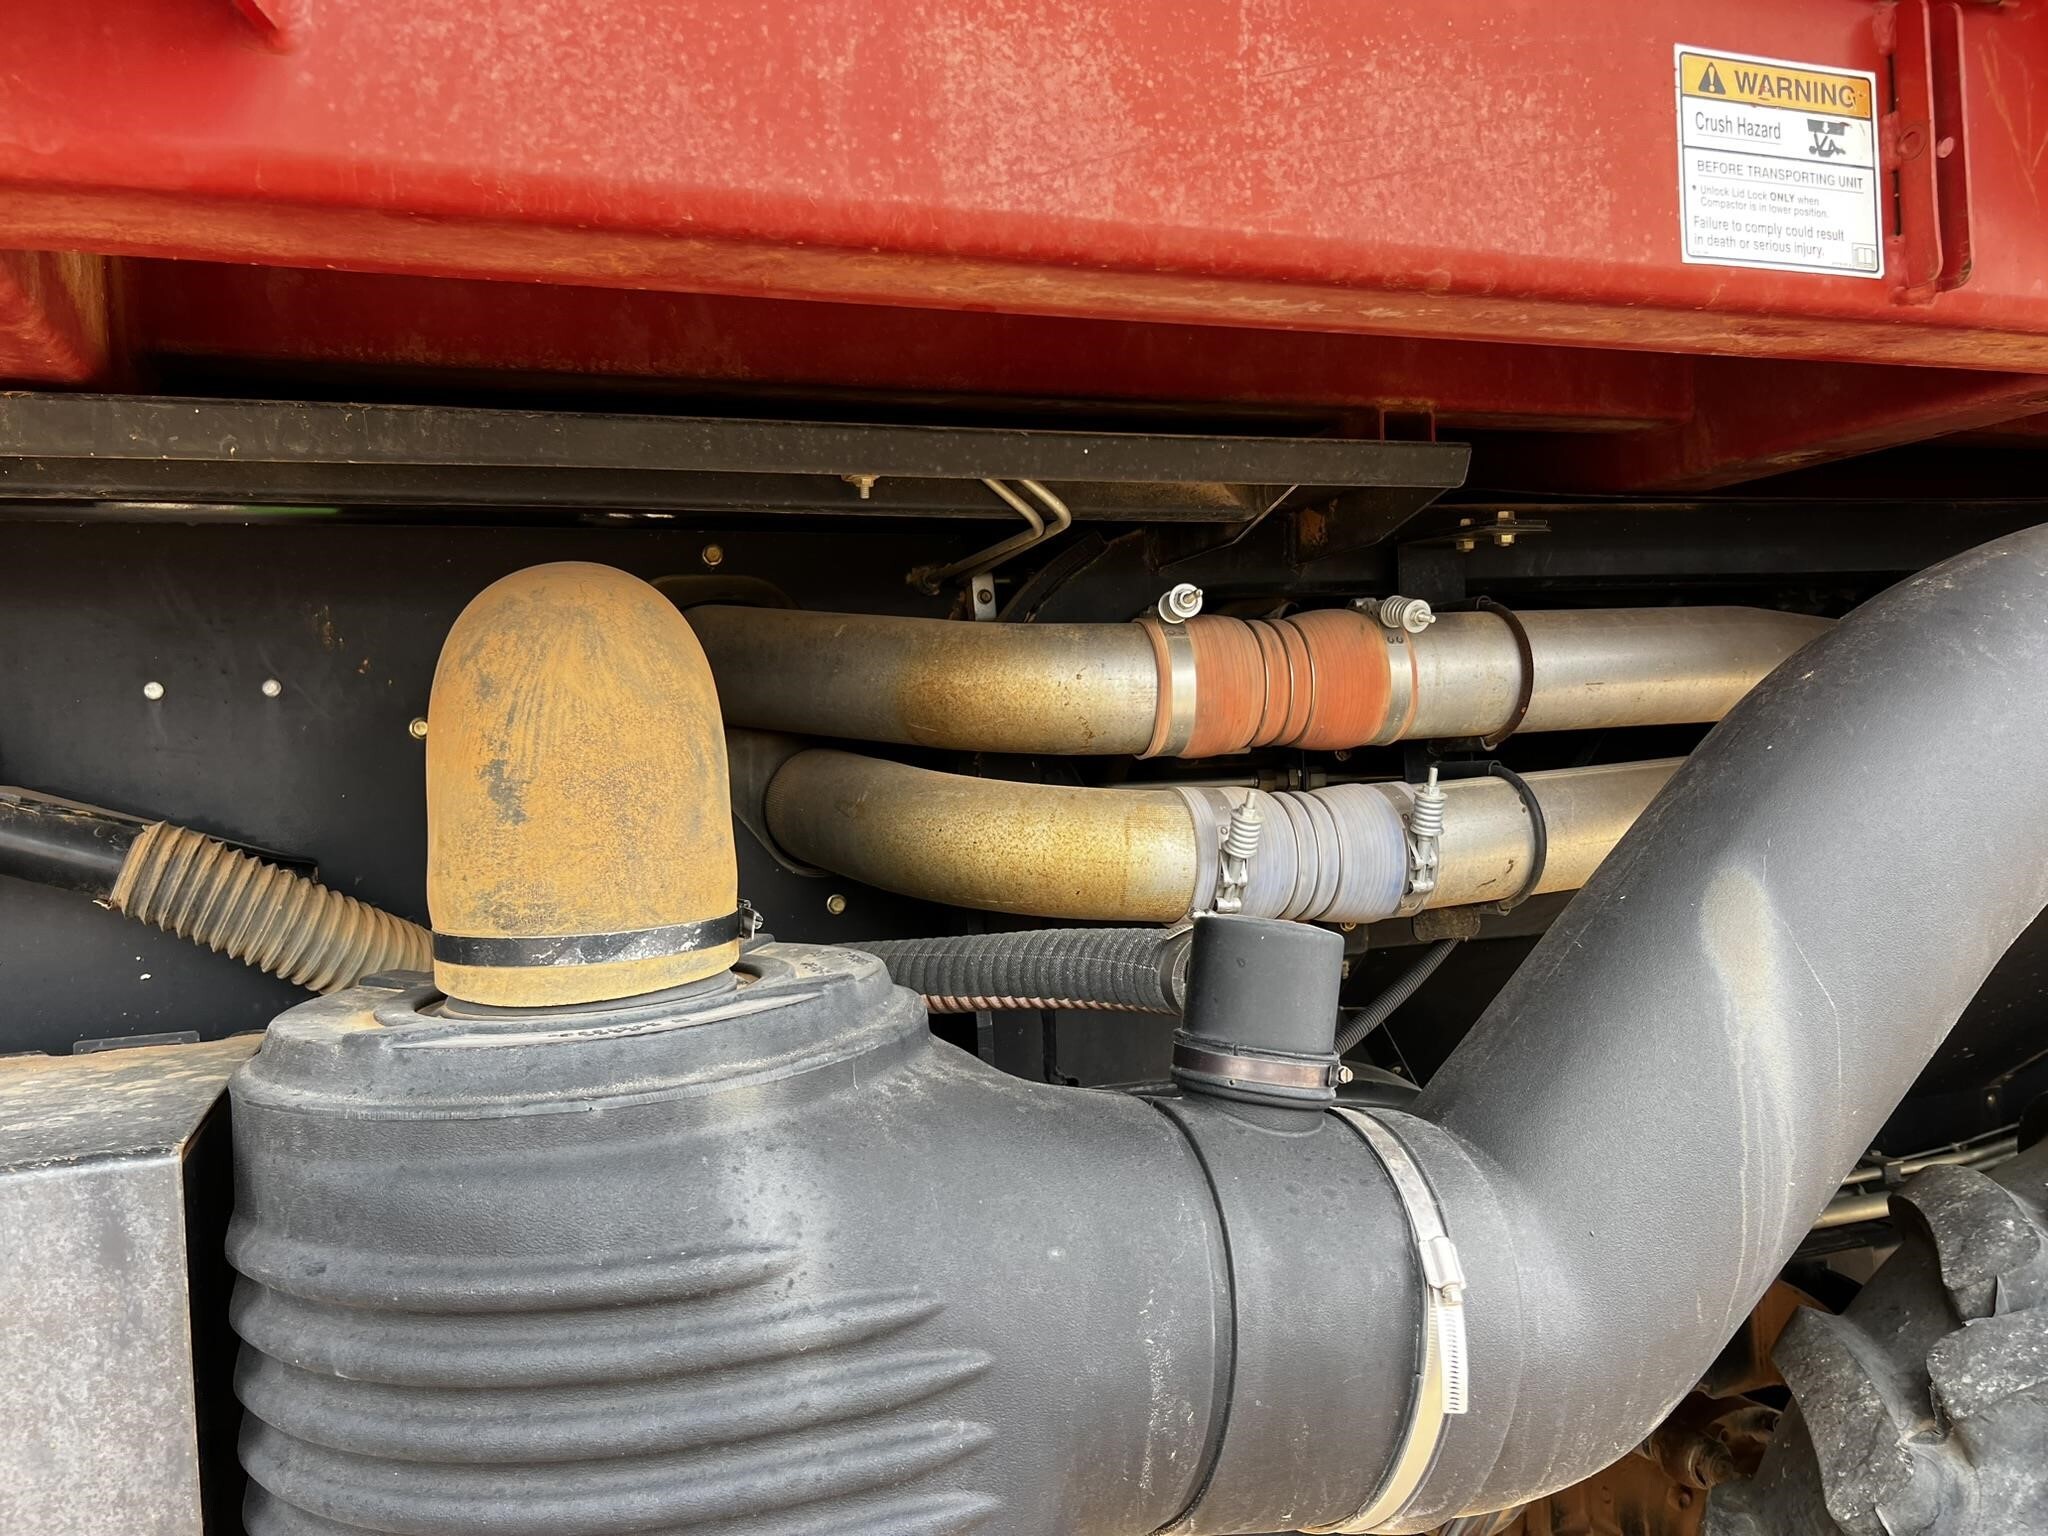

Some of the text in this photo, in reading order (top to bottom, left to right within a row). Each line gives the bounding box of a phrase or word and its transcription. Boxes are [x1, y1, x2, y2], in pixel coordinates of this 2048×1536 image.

[1734, 70, 1857, 109] WARNING
[1695, 111, 1781, 140] Crush Hazard
[1697, 159, 1863, 190] BEFORE TRANSPORTING UNIT
[1700, 184, 1820, 206] Unlock Lid Lock ONLY when
[1700, 196, 1747, 210] Compactor
[1749, 201, 1757, 211] is
[1759, 202, 1767, 213] in
[1768, 203, 1791, 215] lower
[1693, 215, 1846, 242] Failure to comply could result
[1693, 233, 1825, 259] in death or serious injury.
